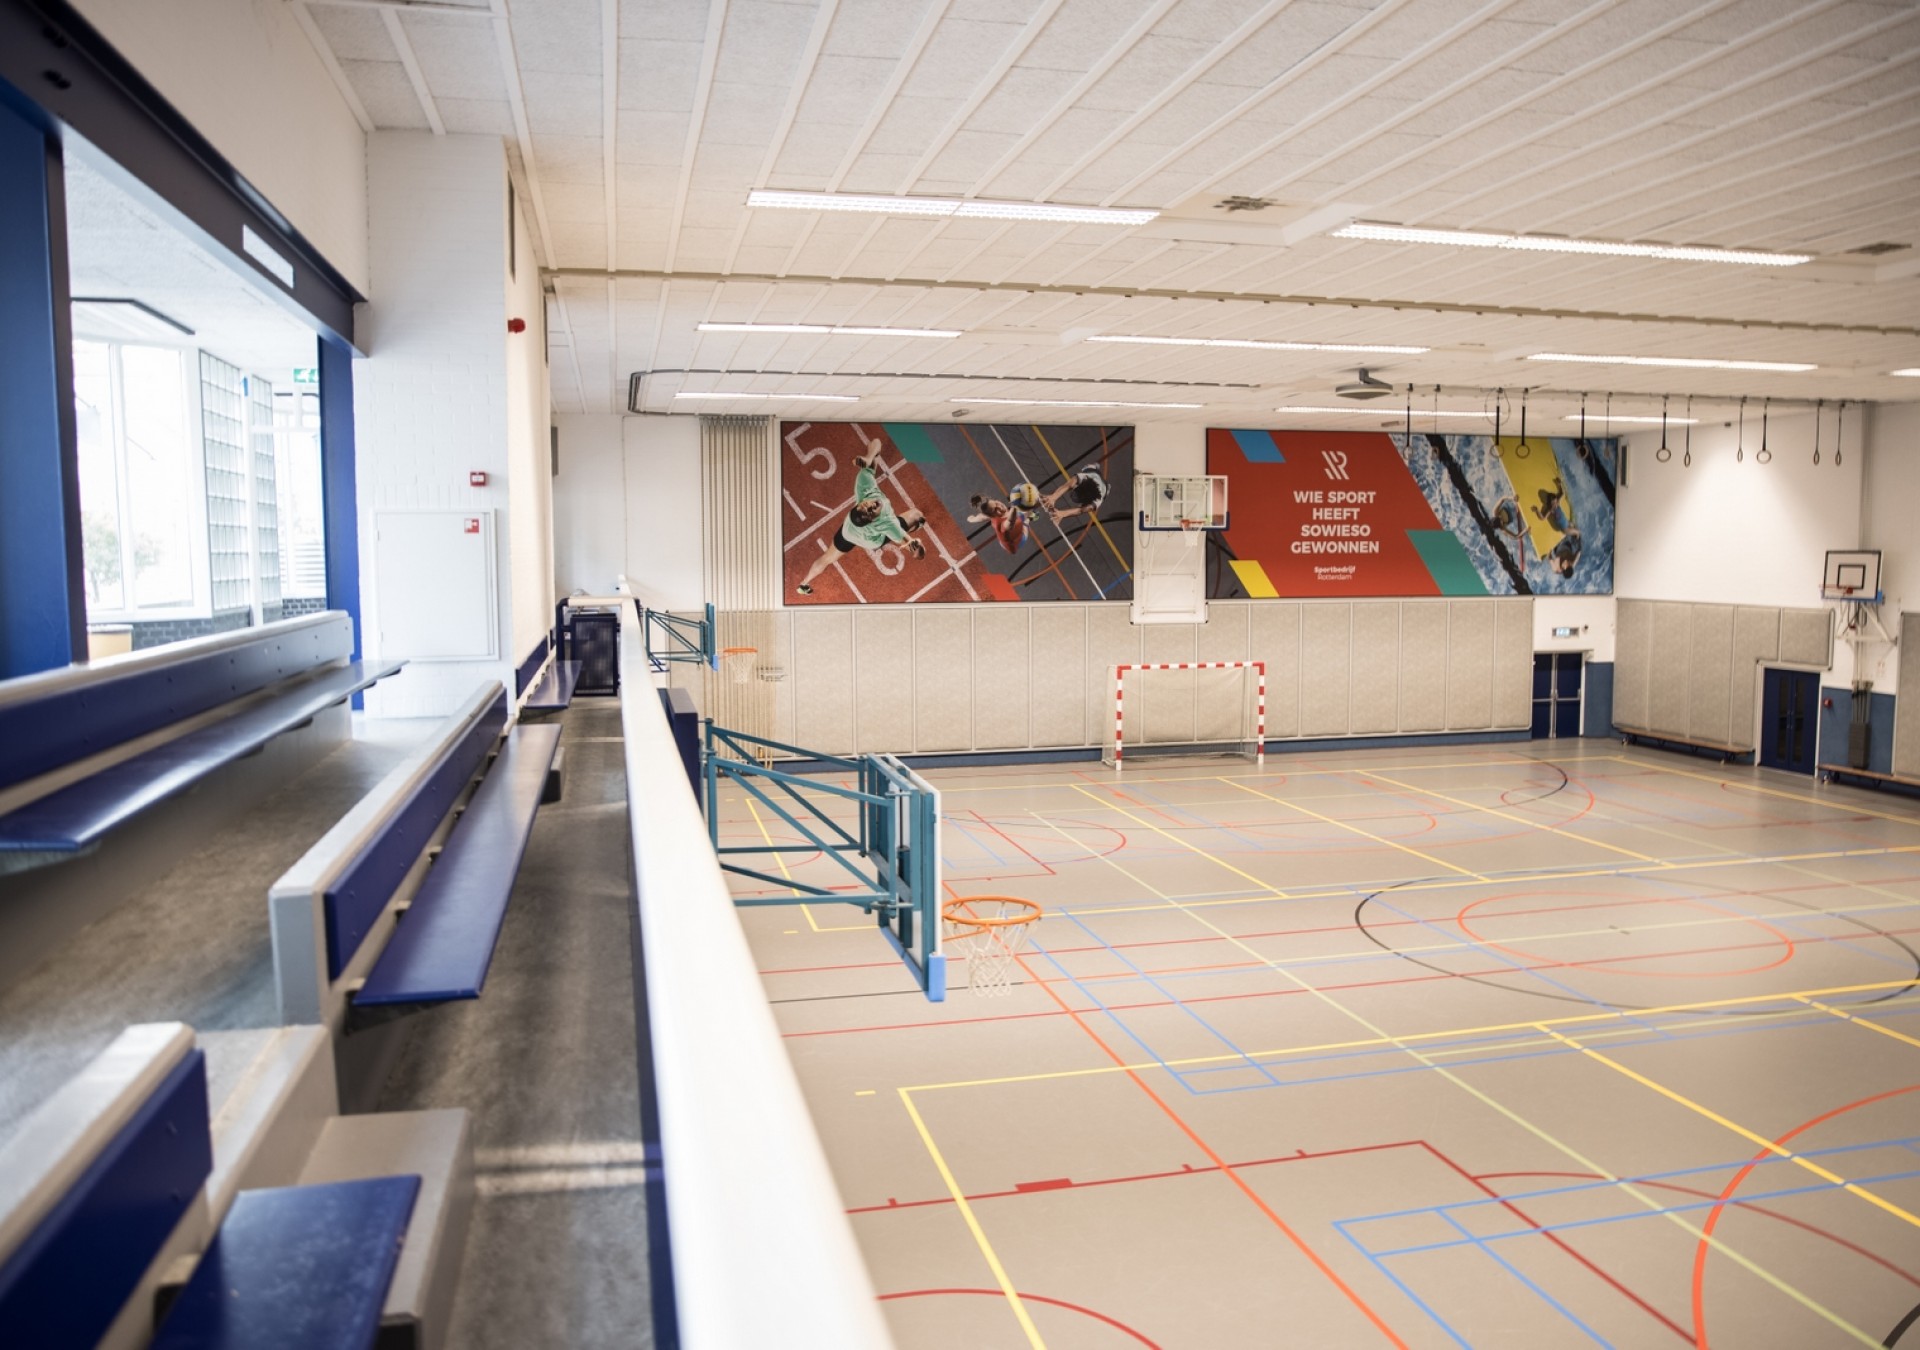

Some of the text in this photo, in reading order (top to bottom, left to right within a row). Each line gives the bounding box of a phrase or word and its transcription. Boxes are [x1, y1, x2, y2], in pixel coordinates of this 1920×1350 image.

[785, 423, 837, 480] 5
[1293, 490, 1376, 504] WIE SPORT
[1312, 507, 1360, 520] HEEFT
[1301, 524, 1371, 537] SOWIESO
[1291, 541, 1380, 554] GEWONNEN
